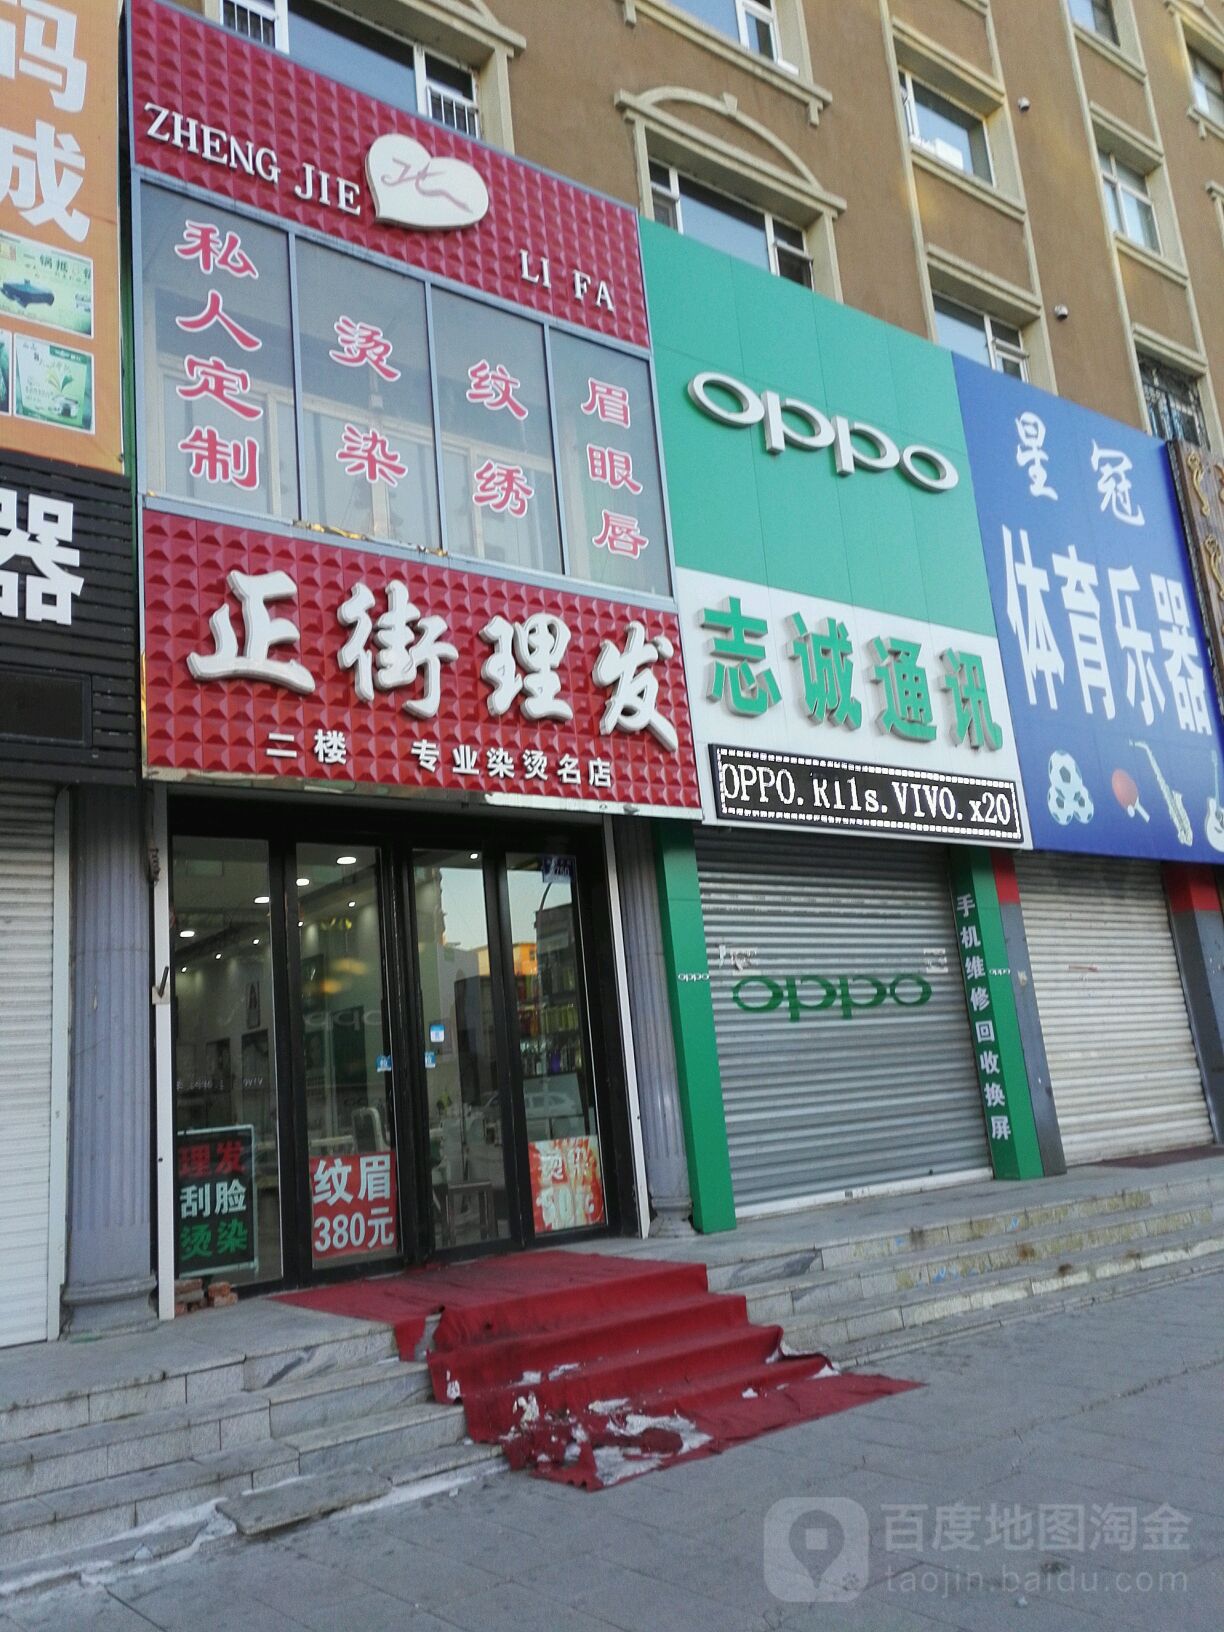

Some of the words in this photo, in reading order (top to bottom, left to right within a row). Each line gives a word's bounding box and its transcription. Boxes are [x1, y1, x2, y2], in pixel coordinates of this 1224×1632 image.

[0, 118, 91, 243] 成
[145, 102, 281, 185] ZHENG
[294, 161, 362, 216] JIE
[520, 249, 551, 289] LI
[572, 270, 615, 312] FA
[175, 218, 263, 492] 私人定制
[329, 315, 409, 487] 烫染
[466, 359, 535, 519] 纹绣
[581, 377, 650, 560] 眉眼唇
[1014, 411, 1146, 527] 星冠
[0, 487, 84, 626] 器
[187, 570, 679, 752] 正街理发
[698, 596, 1004, 753] 志诚通讯
[1002, 523, 1213, 736] 体育乐器
[266, 729, 348, 766] 二楼
[410, 738, 612, 789] 专业染烫名店
[957, 893, 1012, 1141] 手机维修回收换屏
[178, 1139, 246, 1178] 理发
[180, 1178, 247, 1219] 刮脸
[313, 1154, 391, 1207] 纹眉
[180, 1218, 248, 1262] 烫染
[314, 1206, 395, 1253] 380元
